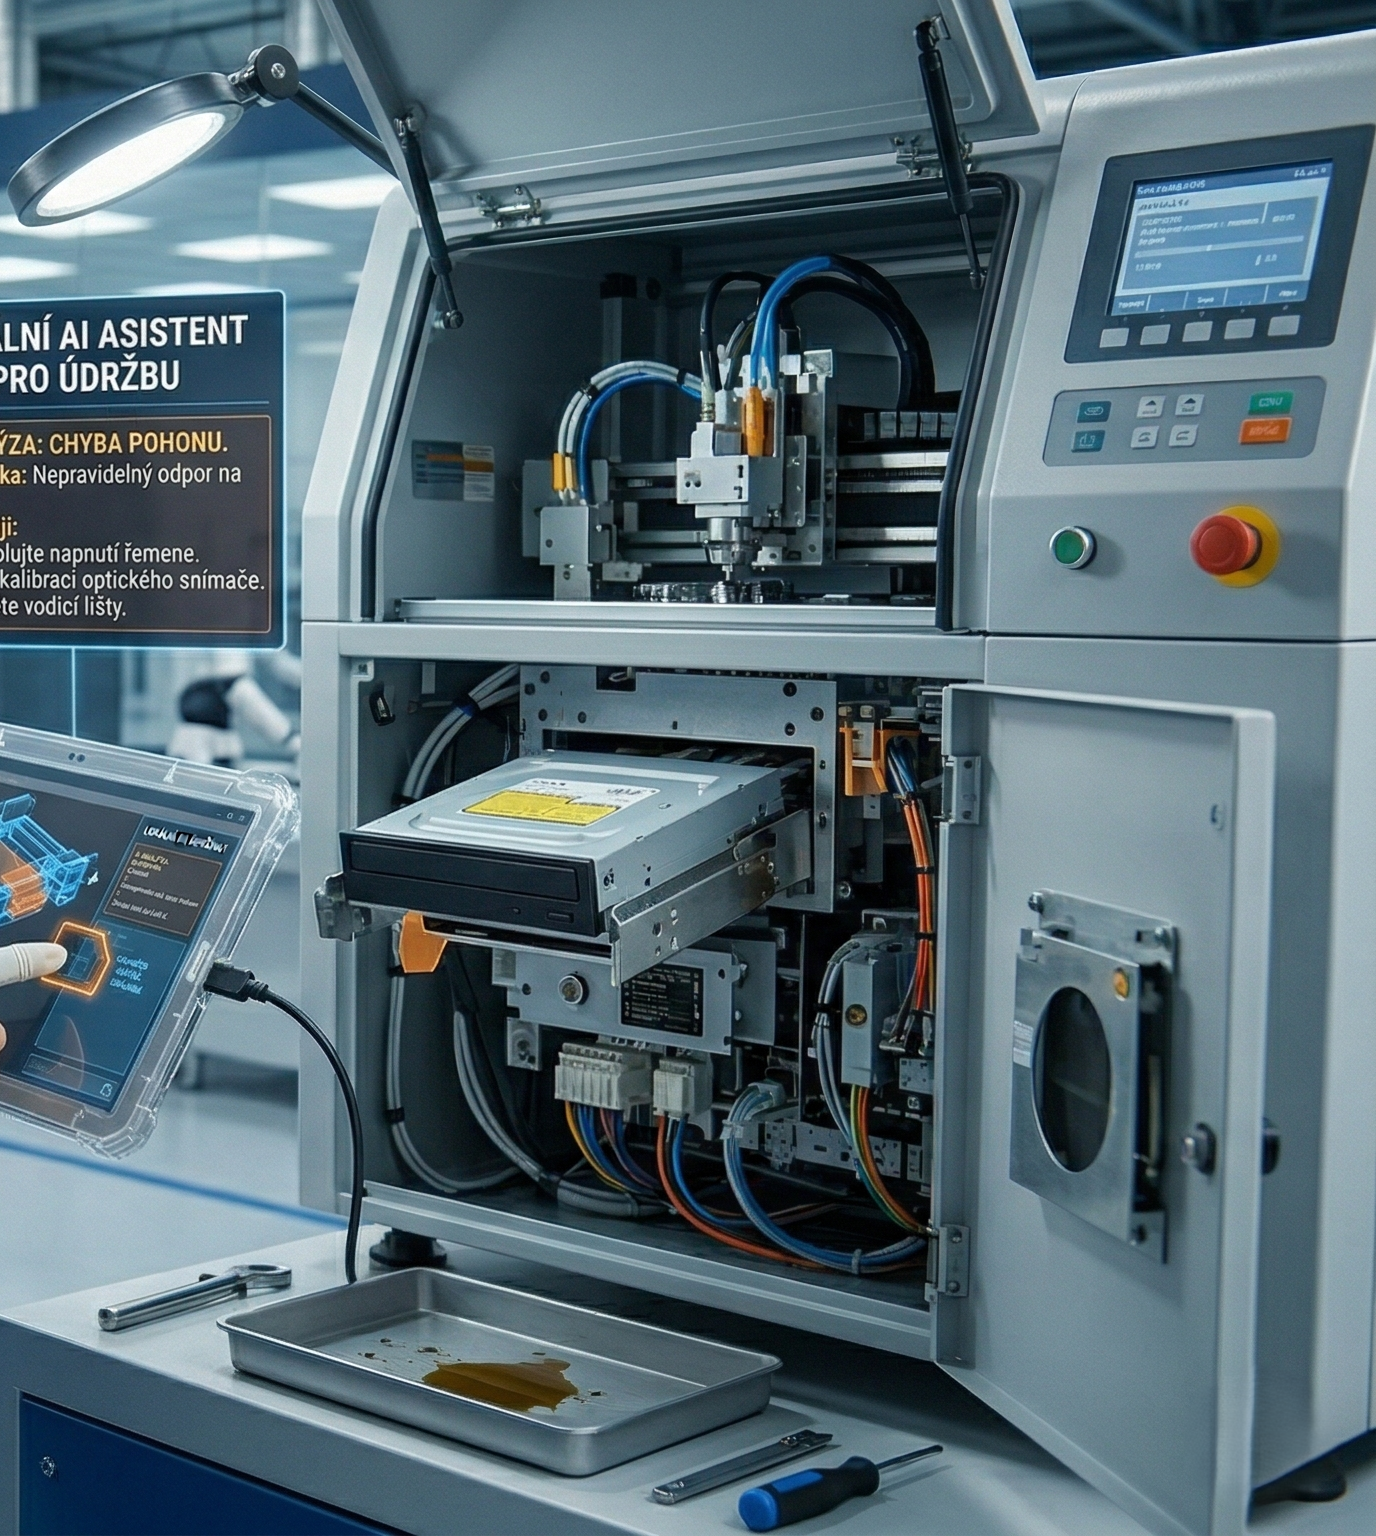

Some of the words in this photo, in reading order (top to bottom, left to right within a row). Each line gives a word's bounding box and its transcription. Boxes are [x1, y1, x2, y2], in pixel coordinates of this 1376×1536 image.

[58, 320, 89, 351] AI
[97, 314, 249, 349] ASISTENT
[59, 352, 180, 393] ÚDRŽBU
[49, 432, 123, 455] CHYBA
[129, 430, 228, 453] POHONU.
[33, 462, 153, 490] Nepravidelný
[157, 464, 213, 489] odpor
[219, 466, 242, 483] na
[50, 541, 120, 568] napnutí
[124, 542, 200, 563] řemene.
[0, 568, 76, 589] kalibraci
[82, 568, 174, 593] optického
[179, 568, 265, 590] snímače.
[23, 594, 80, 616] vodicí
[84, 595, 126, 622] lišty.
